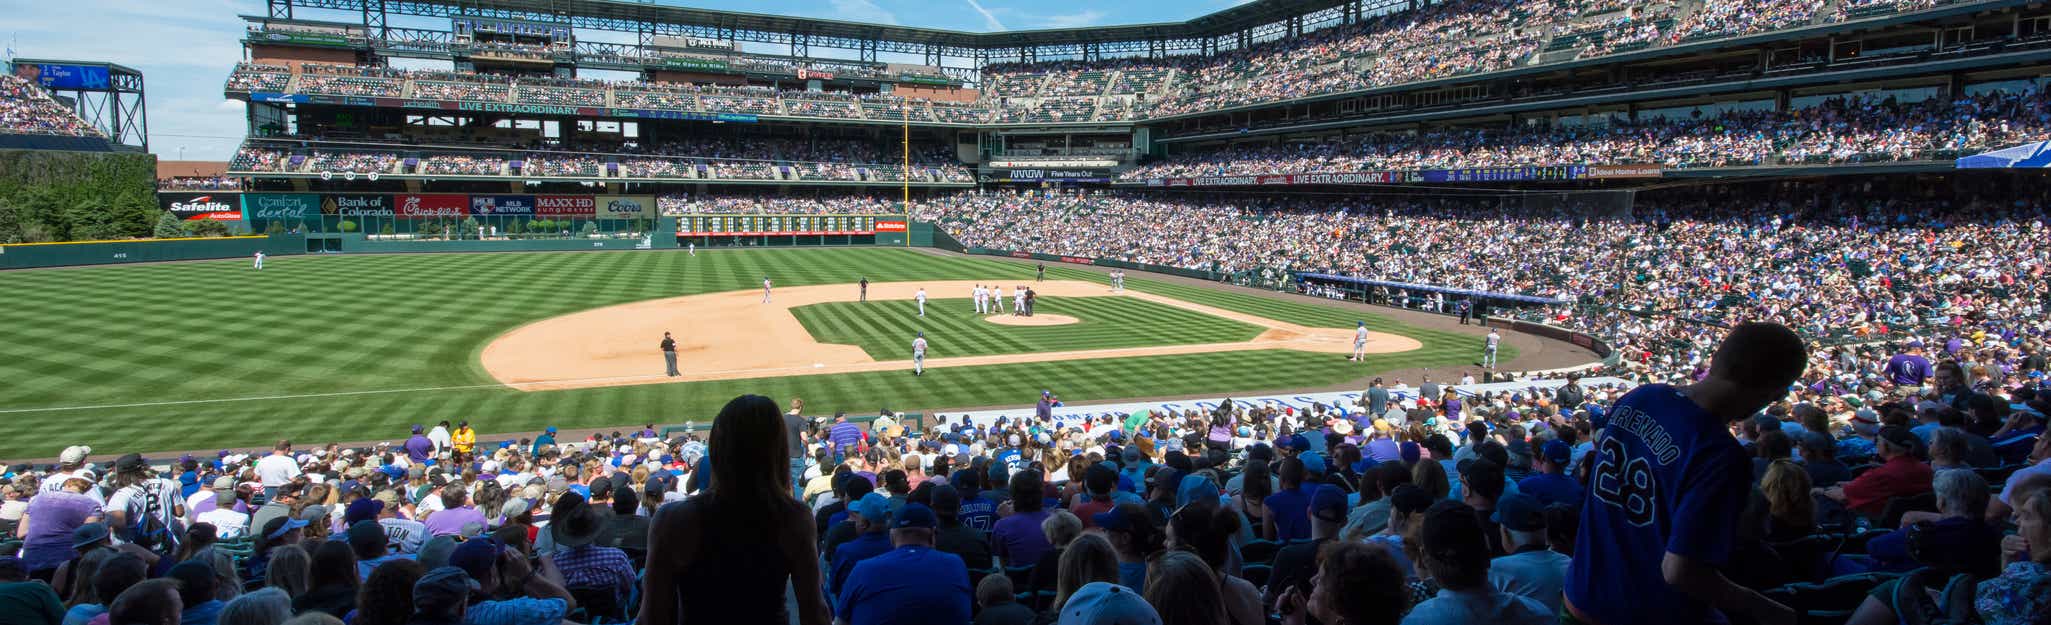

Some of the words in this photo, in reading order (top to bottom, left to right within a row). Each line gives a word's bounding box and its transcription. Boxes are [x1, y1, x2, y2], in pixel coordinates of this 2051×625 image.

[458, 101, 482, 110] LIVE
[485, 102, 580, 115] EXTRAORDINARY.
[1597, 167, 1614, 175] Ideal
[1615, 166, 1637, 175] Home
[1638, 166, 1660, 174] Loans
[1193, 177, 1205, 185] LIVE
[1206, 176, 1259, 185] EXTRAORDINARY.
[1293, 175, 1309, 184] LIVE
[1310, 172, 1384, 184] EXTRAORDINARY.
[338, 196, 368, 207] Bank
[370, 196, 383, 207] of
[537, 198, 574, 207] MAXX
[575, 198, 594, 207] HD
[607, 200, 642, 213] Coors
[256, 203, 307, 219] dental
[338, 206, 393, 217] Colorado
[1593, 435, 1655, 528] 28
